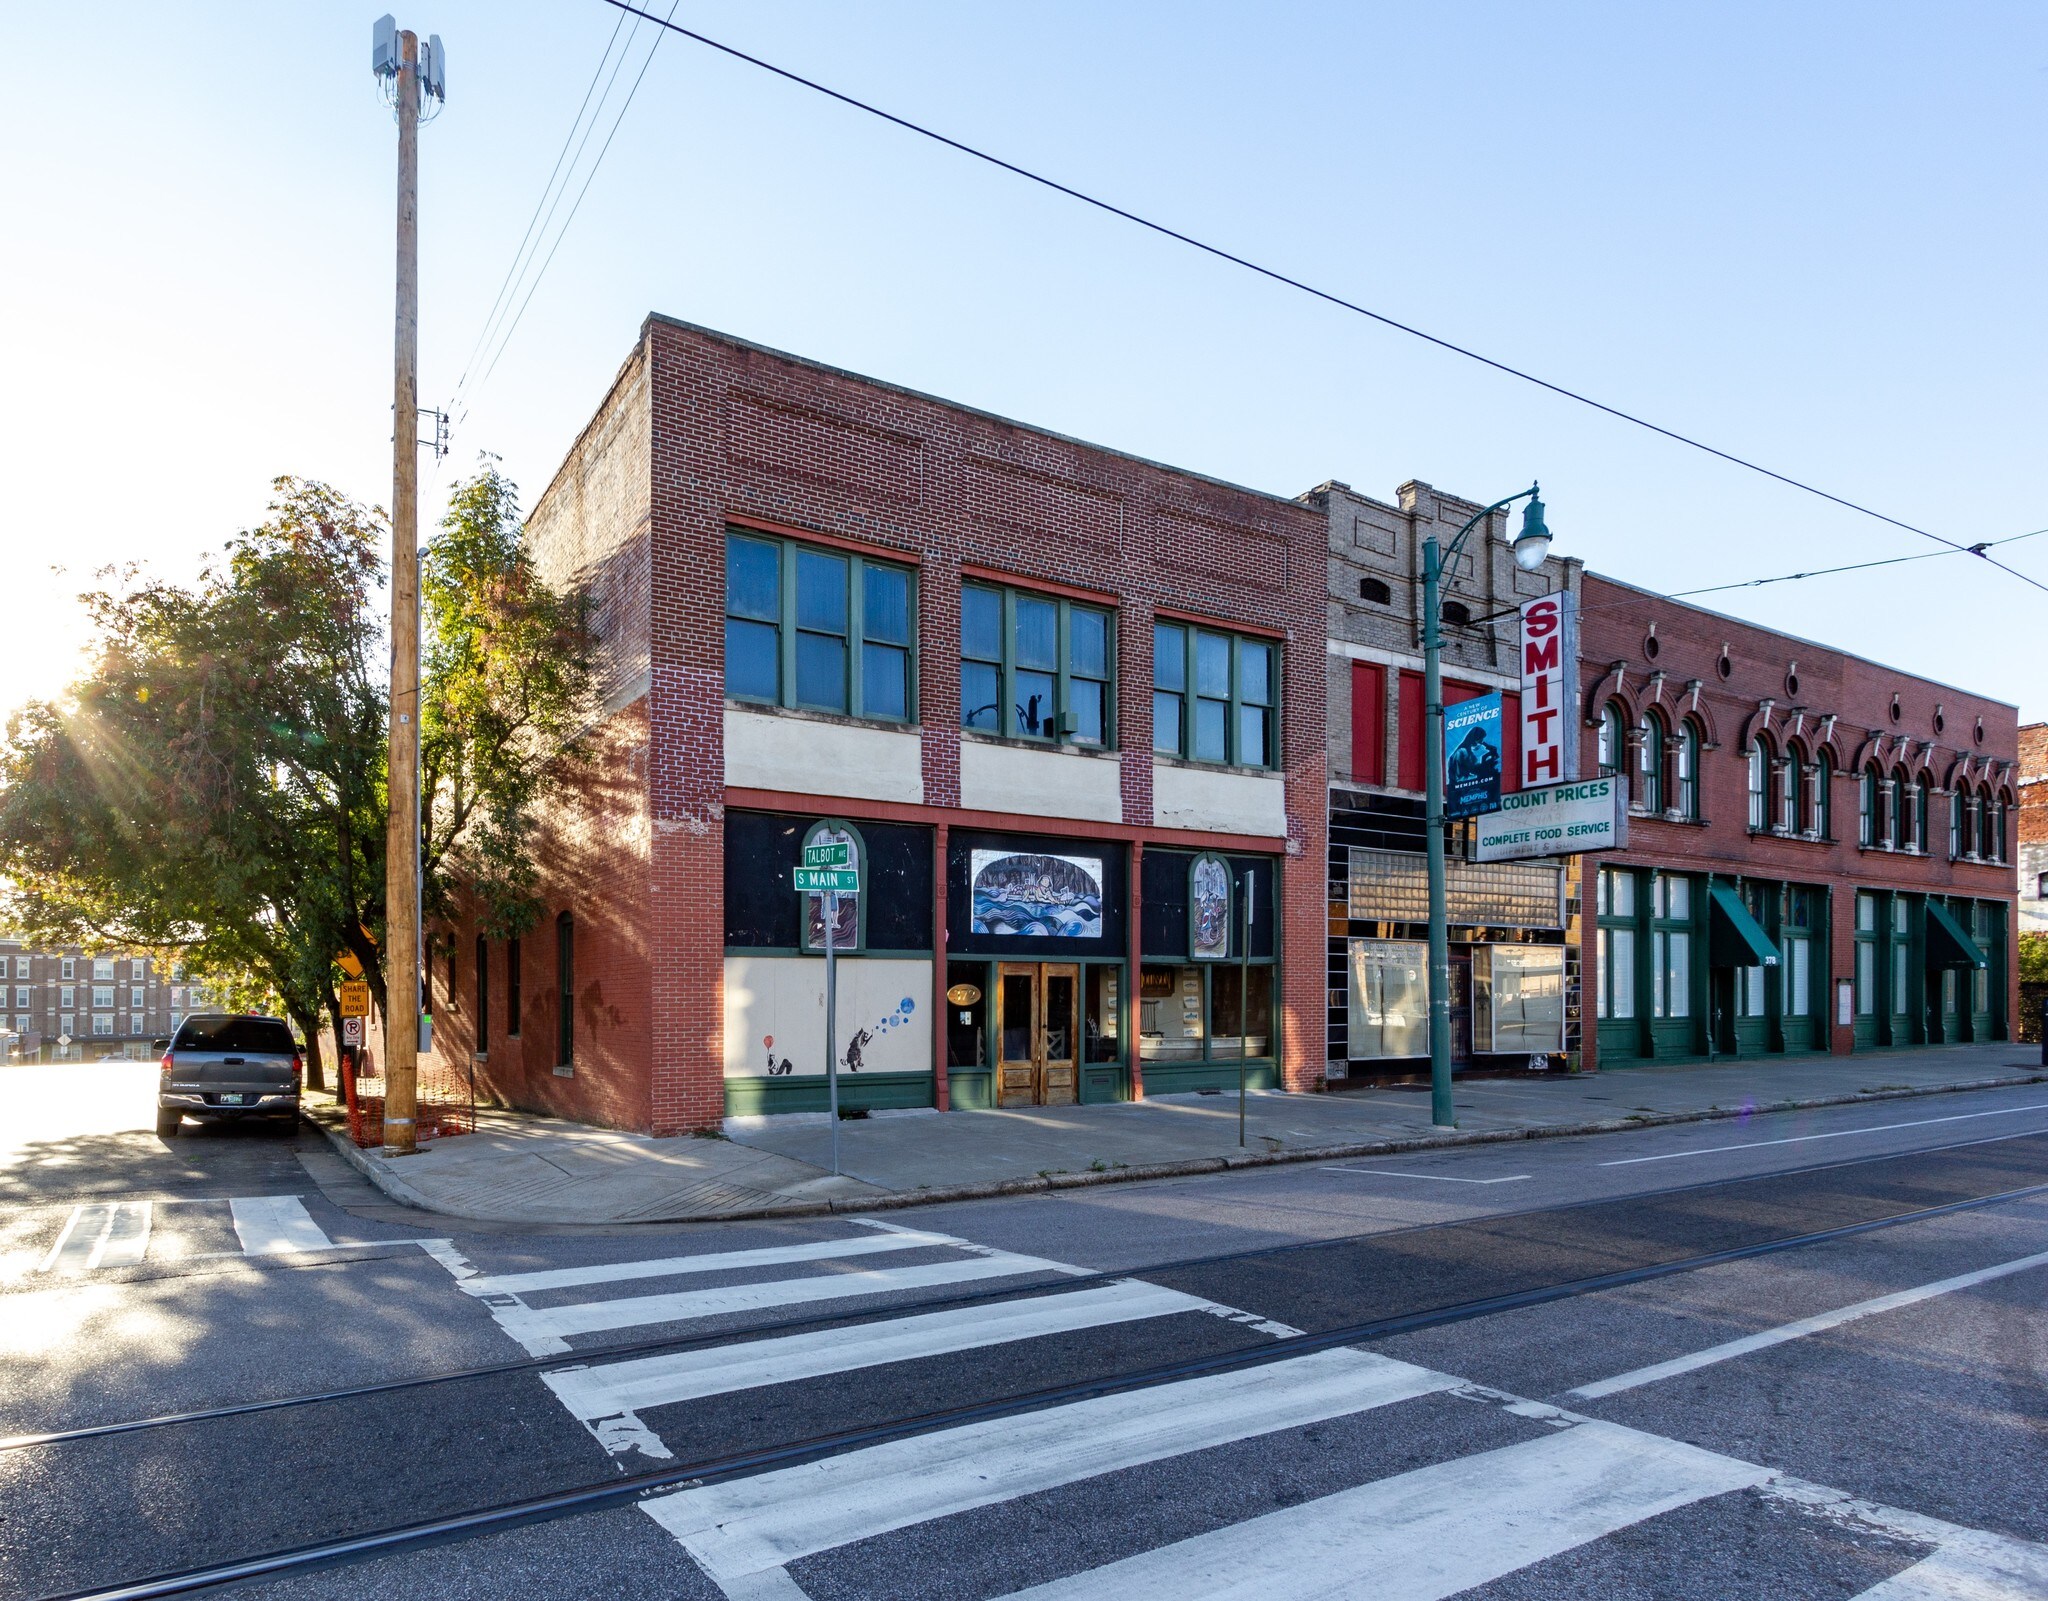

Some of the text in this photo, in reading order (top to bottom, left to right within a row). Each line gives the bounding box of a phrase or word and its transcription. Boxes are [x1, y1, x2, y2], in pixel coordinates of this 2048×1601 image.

[1525, 601, 1558, 783] SMITH
[1446, 707, 1500, 731] SCIENCE
[1460, 790, 1488, 805] MEMPHIS
[1501, 791, 1548, 811] COUNT
[1555, 781, 1609, 802] PRICES
[1482, 831, 1530, 847] COMPLETE
[1534, 828, 1562, 841] FOOD
[1567, 821, 1610, 837] SERVICE
[807, 847, 846, 863] TALBOT AVE
[798, 871, 854, 887] S MAIN ST
[1765, 956, 1776, 965] 378
[343, 985, 366, 993] SHARE
[953, 988, 976, 1001] 372
